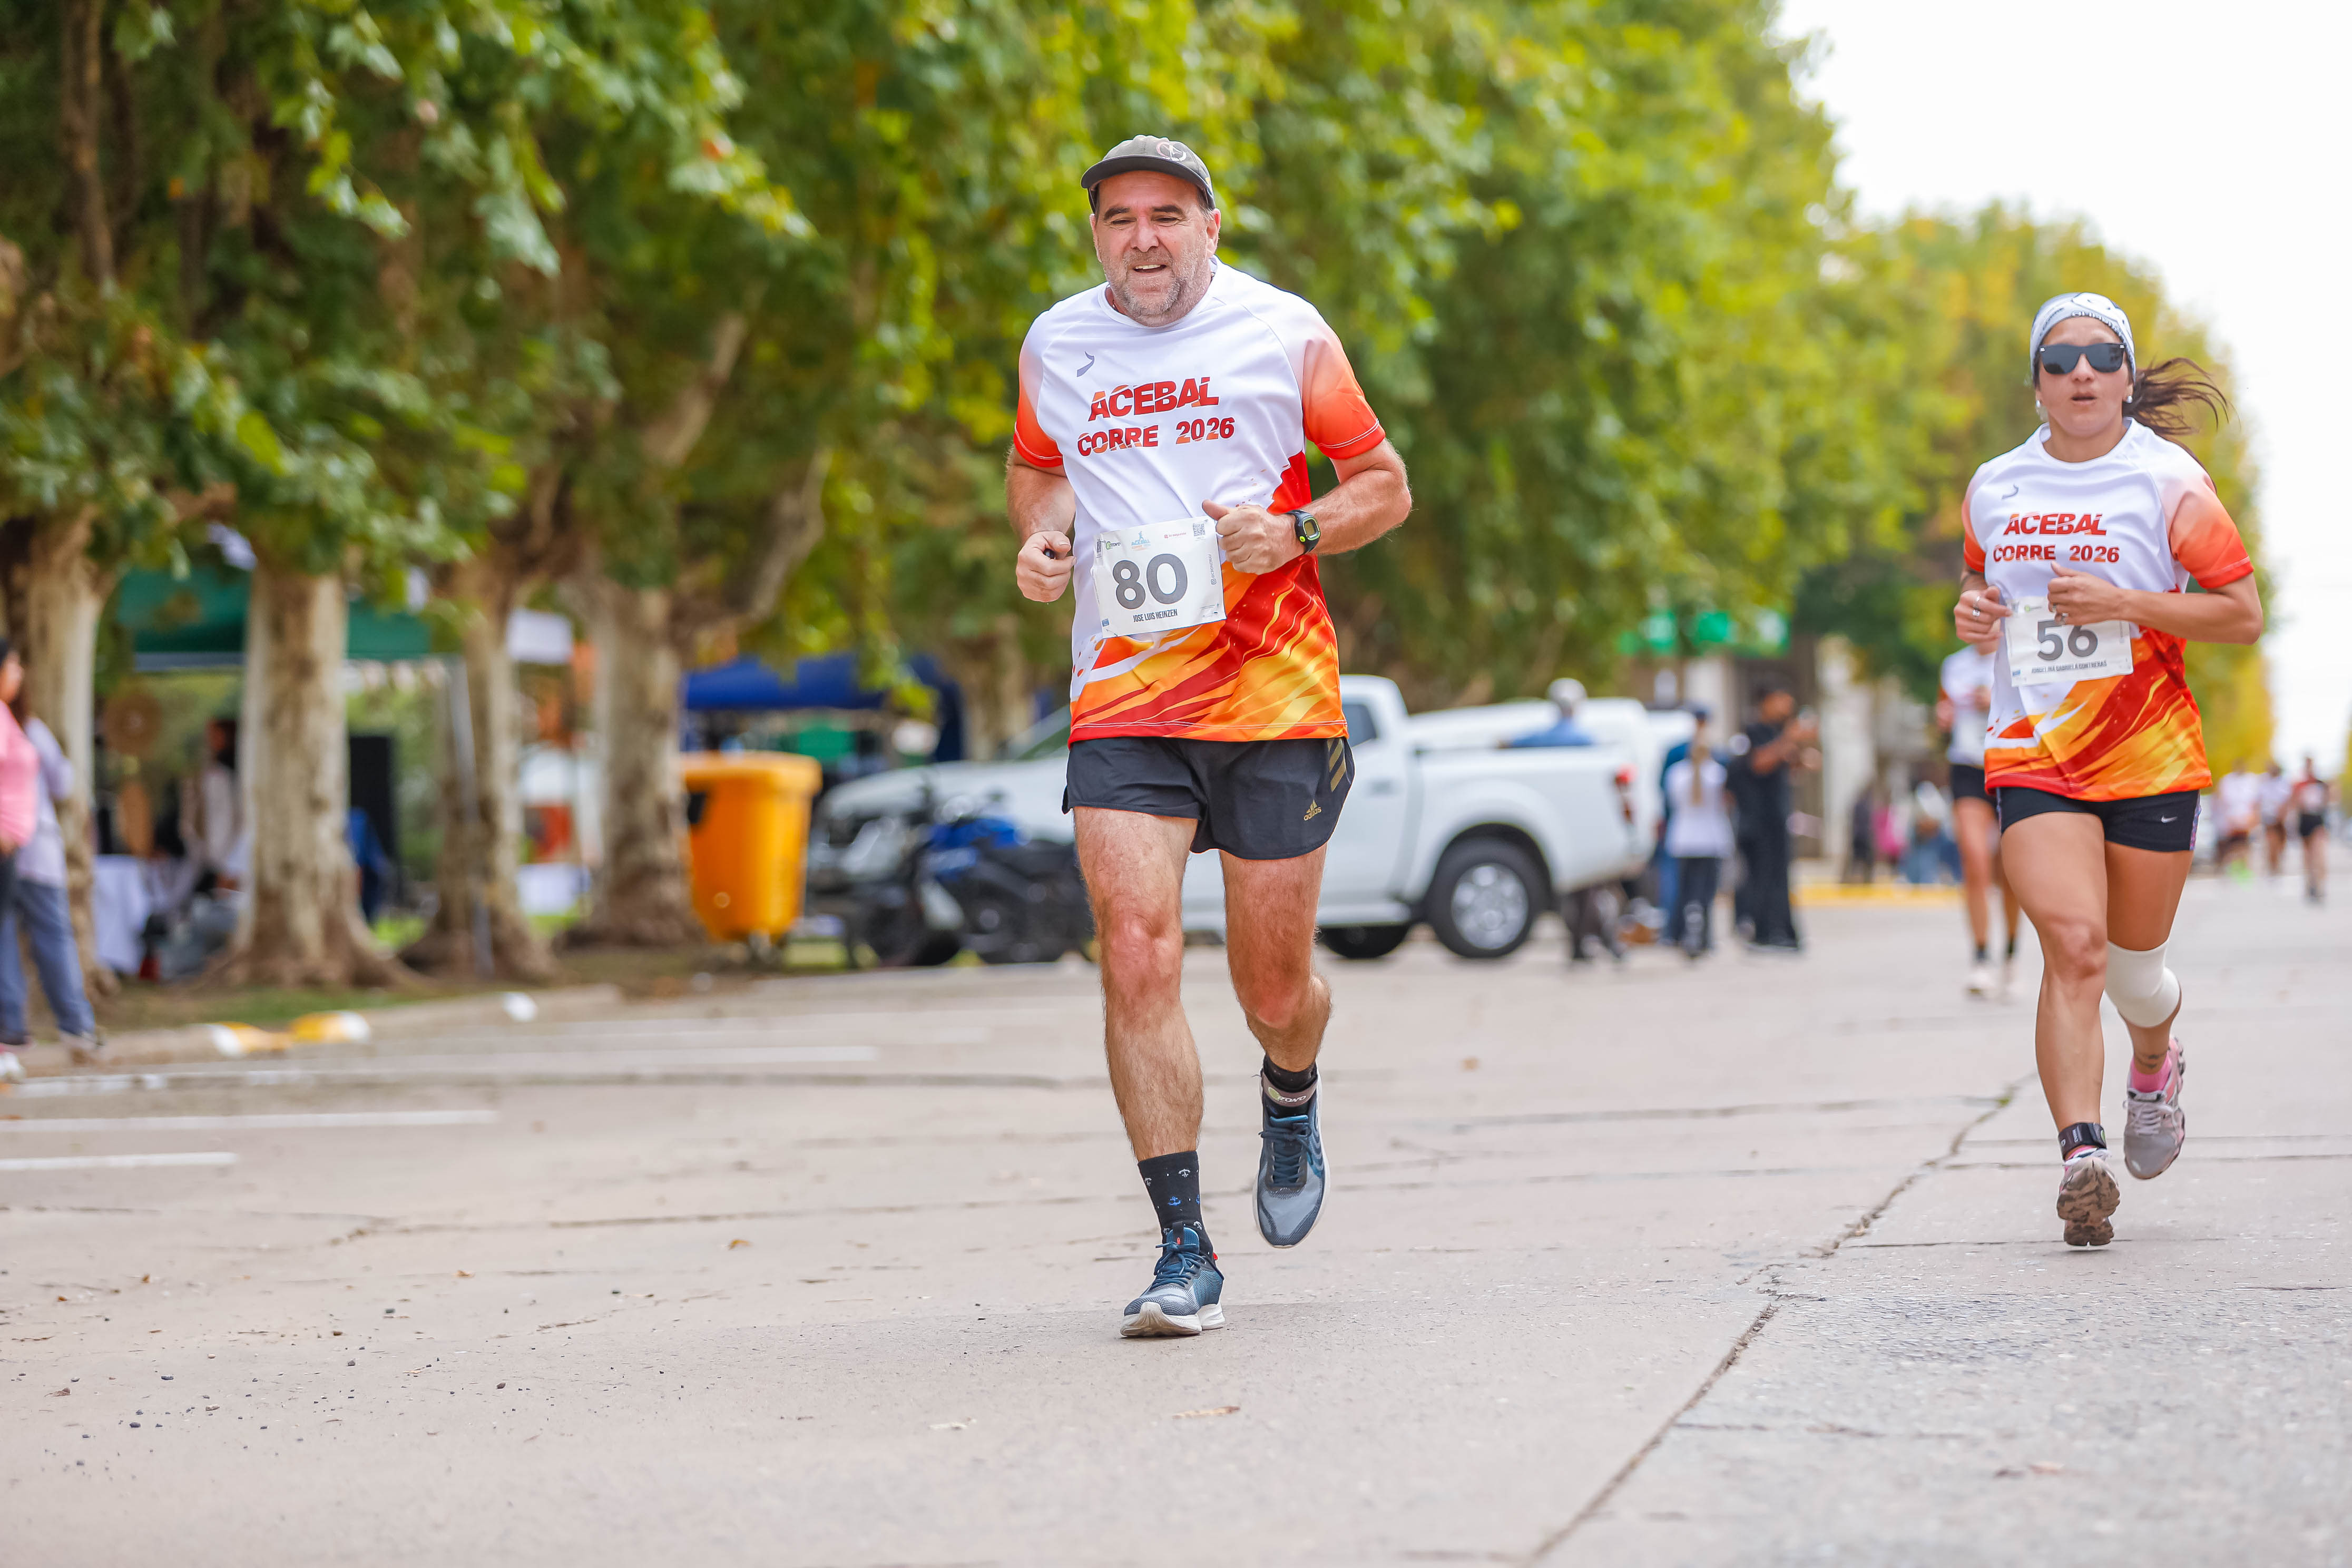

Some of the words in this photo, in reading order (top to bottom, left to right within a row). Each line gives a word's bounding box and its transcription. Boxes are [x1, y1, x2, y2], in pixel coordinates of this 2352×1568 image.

[1087, 377, 1219, 422] ACEBAL
[1077, 425, 1159, 457] CORRE
[1175, 417, 1236, 445] 2026
[2003, 513, 2107, 536] ACEBAL
[1993, 544, 2056, 562] CORRE
[2069, 545, 2120, 563] 2026
[1112, 553, 1188, 610] 80
[1133, 614, 1144, 623] JOSE
[1144, 612, 1156, 621] LUIS
[1155, 609, 1178, 620] HEINZEN
[2037, 620, 2099, 661] 56
[1304, 807, 1322, 821] adidas
